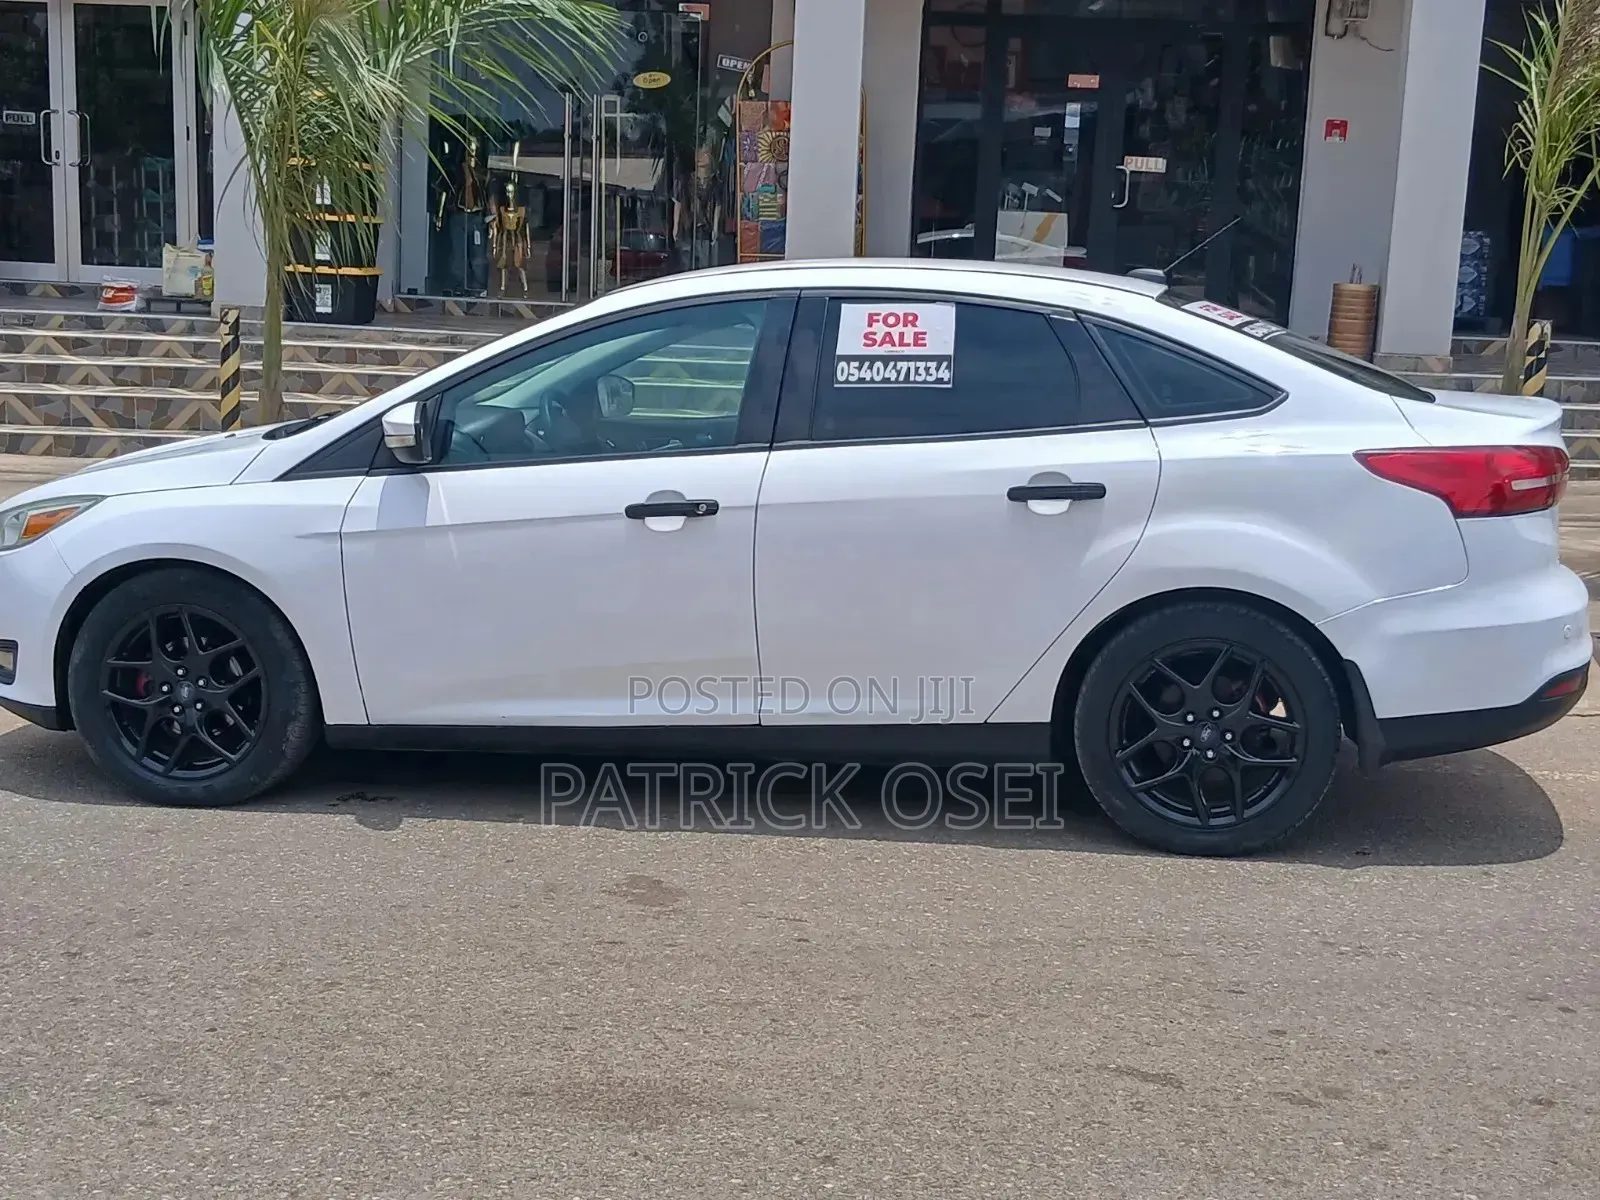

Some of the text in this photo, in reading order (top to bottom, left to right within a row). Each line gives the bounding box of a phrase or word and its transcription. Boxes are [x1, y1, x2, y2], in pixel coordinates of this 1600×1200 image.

[6, 114, 34, 123] PULL
[1125, 158, 1162, 170] PULL
[867, 312, 919, 328] FOR
[863, 331, 928, 348] SALE
[836, 361, 951, 382] 0540471334
